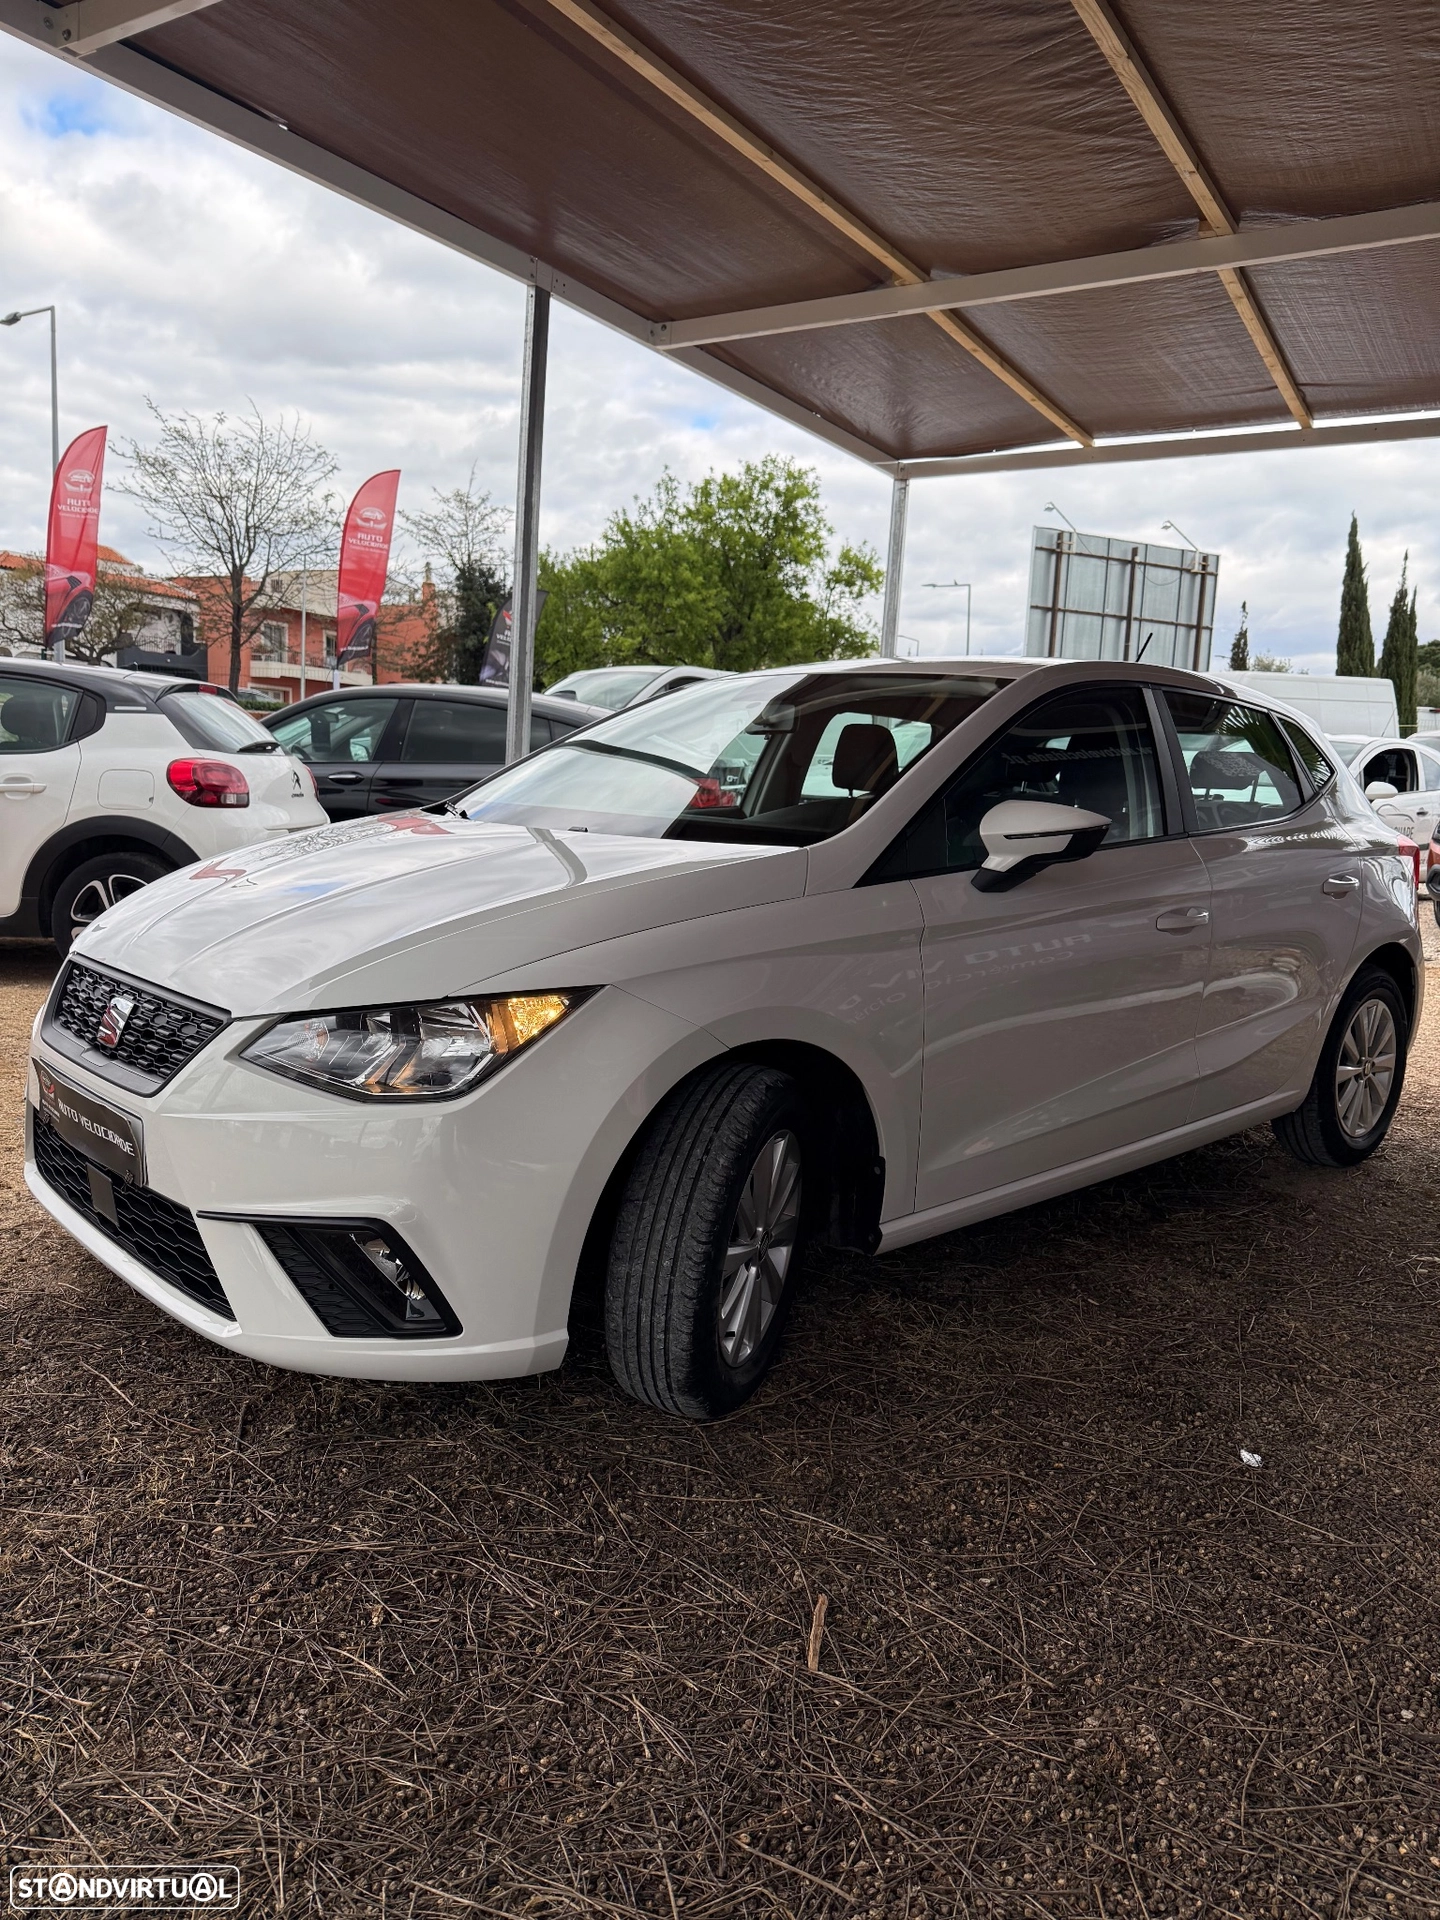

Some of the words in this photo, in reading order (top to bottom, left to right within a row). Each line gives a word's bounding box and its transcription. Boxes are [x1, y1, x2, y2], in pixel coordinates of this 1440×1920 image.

[357, 532, 383, 543] AUTO
[58, 1098, 79, 1123] AUTO
[79, 1112, 135, 1156] VELOCIDADE
